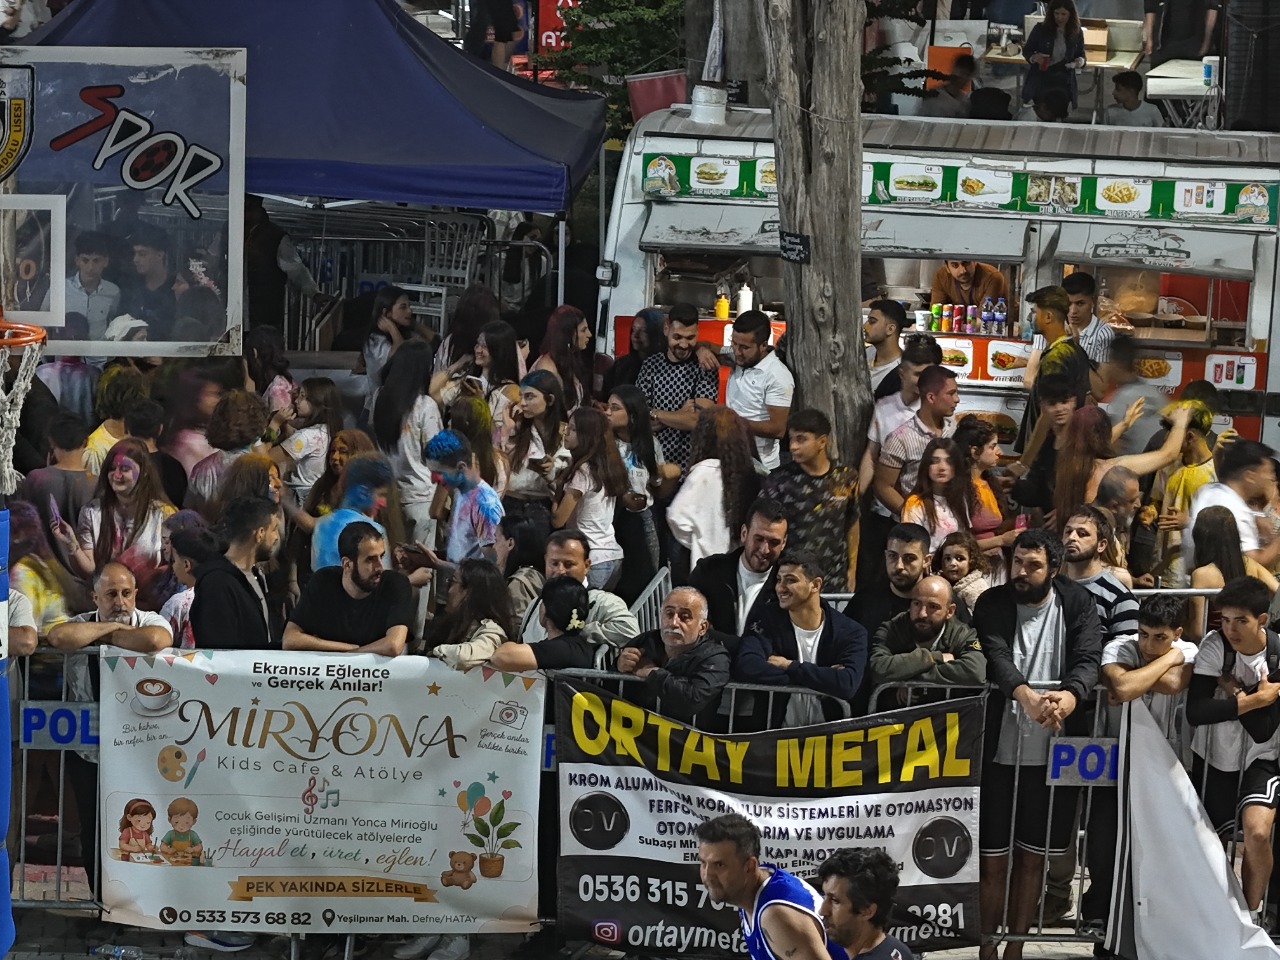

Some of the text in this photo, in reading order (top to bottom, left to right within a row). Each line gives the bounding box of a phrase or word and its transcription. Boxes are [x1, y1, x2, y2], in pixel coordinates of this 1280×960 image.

[49, 84, 223, 220] SPOR
[252, 661, 391, 680] Ekransız Eğlence
[267, 677, 325, 693] Gerçek
[329, 677, 384, 693] Anılar!
[570, 691, 971, 788] ORTAY METAL
[217, 755, 424, 784] Kids Cafe & Atölye
[567, 772, 974, 820] KROM SİSTEMLERİ VE OTOMASYON
[215, 810, 439, 833] Çocuk Gelişimi Uzmanı Yonca Mirioğlu
[229, 825, 423, 845] eşliğinde yürütülecek atölyelerde
[638, 835, 677, 850] Subaşı
[795, 825, 896, 841] VE UYGULAMA
[216, 838, 290, 867] Hayal
[290, 843, 309, 858] et
[322, 846, 362, 862] üret
[376, 847, 438, 874] eğlen!
[764, 846, 798, 861] KAPI
[245, 878, 423, 896] PEK YAKINDA SİZLERLE
[578, 873, 689, 908] 0536 315
[178, 910, 478, 926] 0 533 573 68 82 Yeşilpınar Mah. Defne/HATAY
